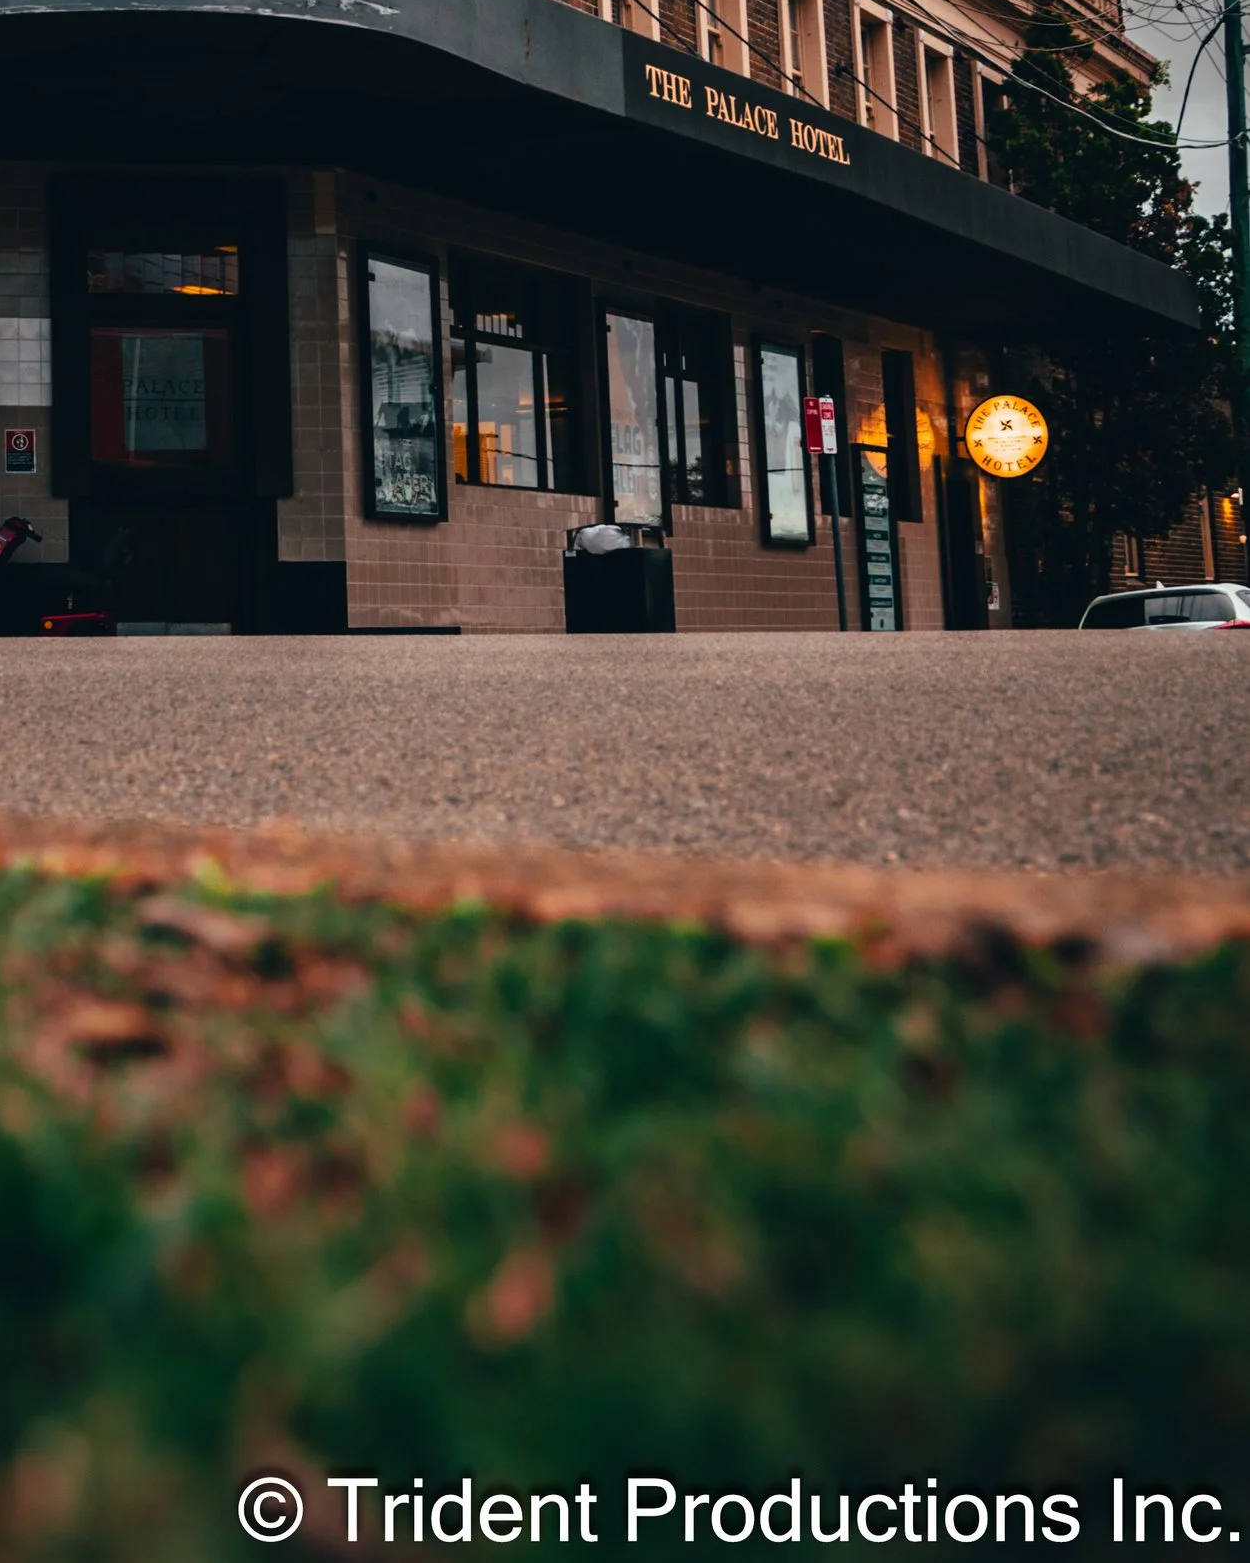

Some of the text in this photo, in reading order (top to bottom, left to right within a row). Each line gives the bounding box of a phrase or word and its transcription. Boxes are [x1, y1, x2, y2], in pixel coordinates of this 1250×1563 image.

[645, 64, 850, 165] THE PALACE HOTEL
[122, 379, 207, 395] PALACE
[125, 406, 201, 422] HOTEL
[974, 401, 1040, 430] THE PALACE
[982, 455, 1037, 472] HOTEL
